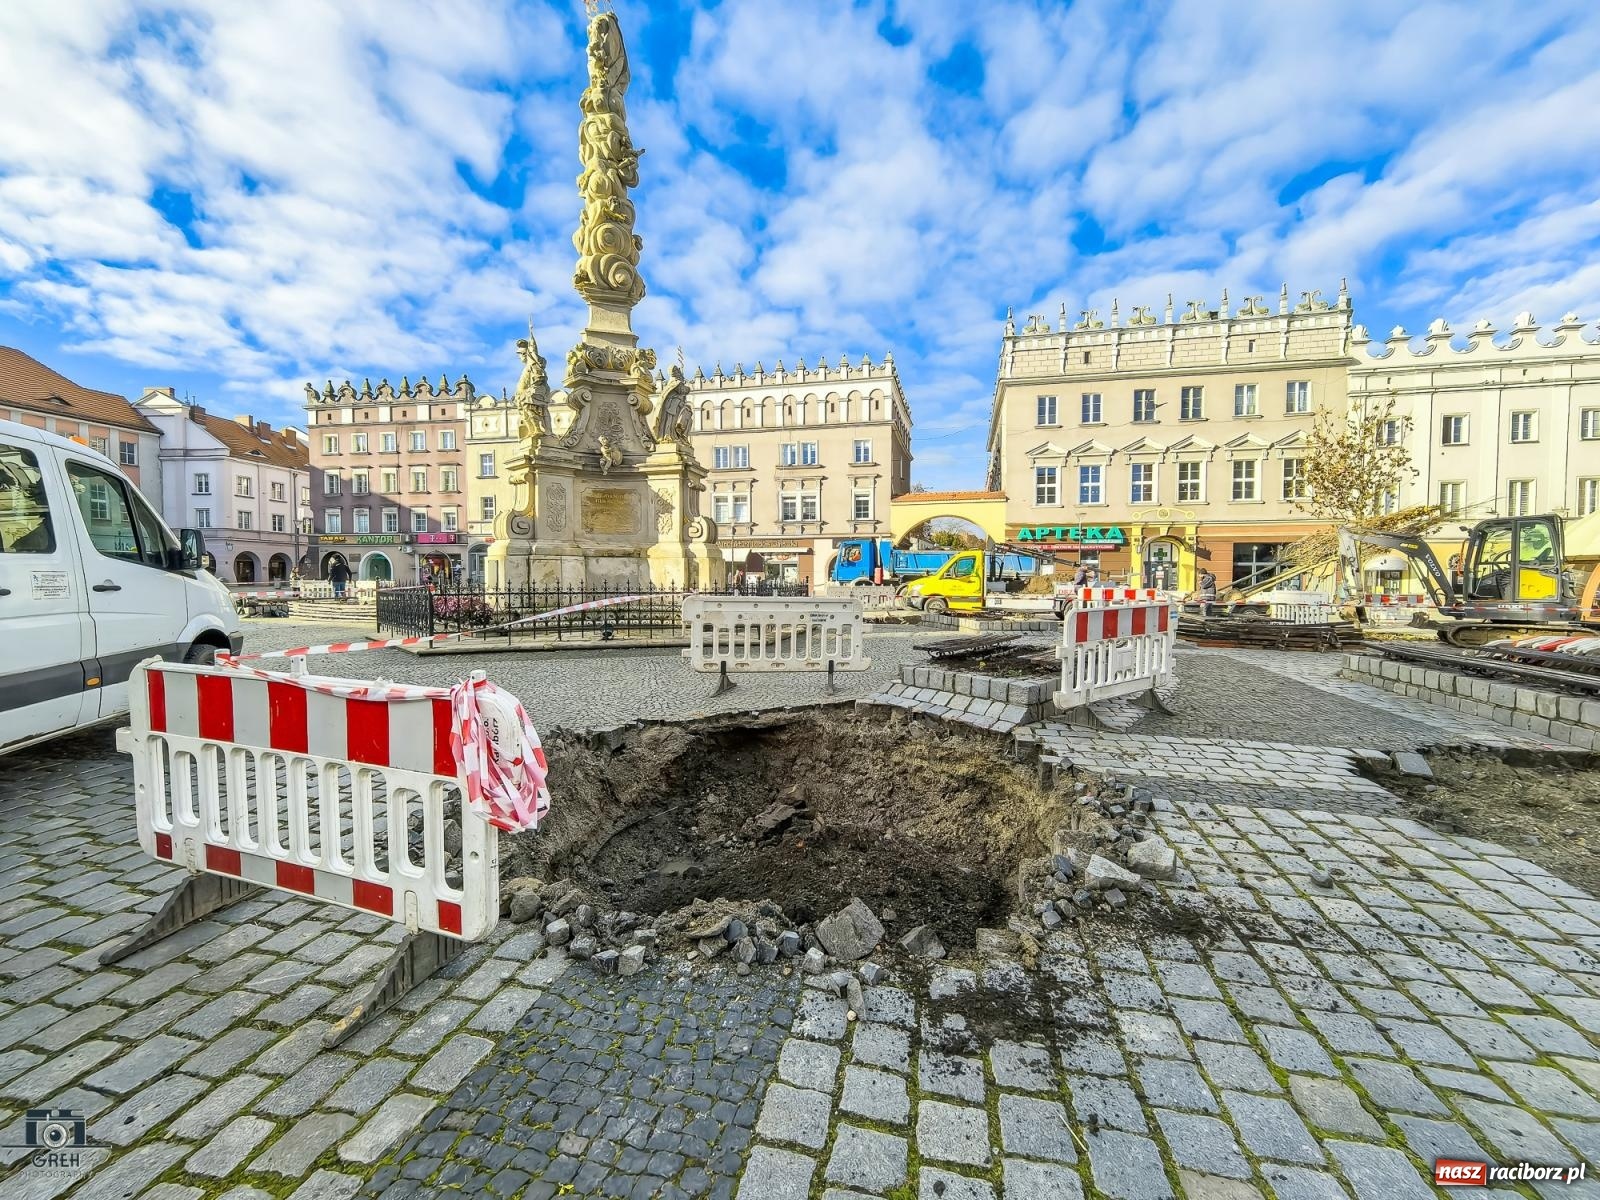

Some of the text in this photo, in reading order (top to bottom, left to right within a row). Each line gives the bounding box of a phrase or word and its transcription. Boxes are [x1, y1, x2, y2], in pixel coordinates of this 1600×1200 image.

[356, 535, 393, 545] KANTOR
[1017, 527, 1124, 540] APTEKA
[1426, 553, 1441, 577] VOLVO
